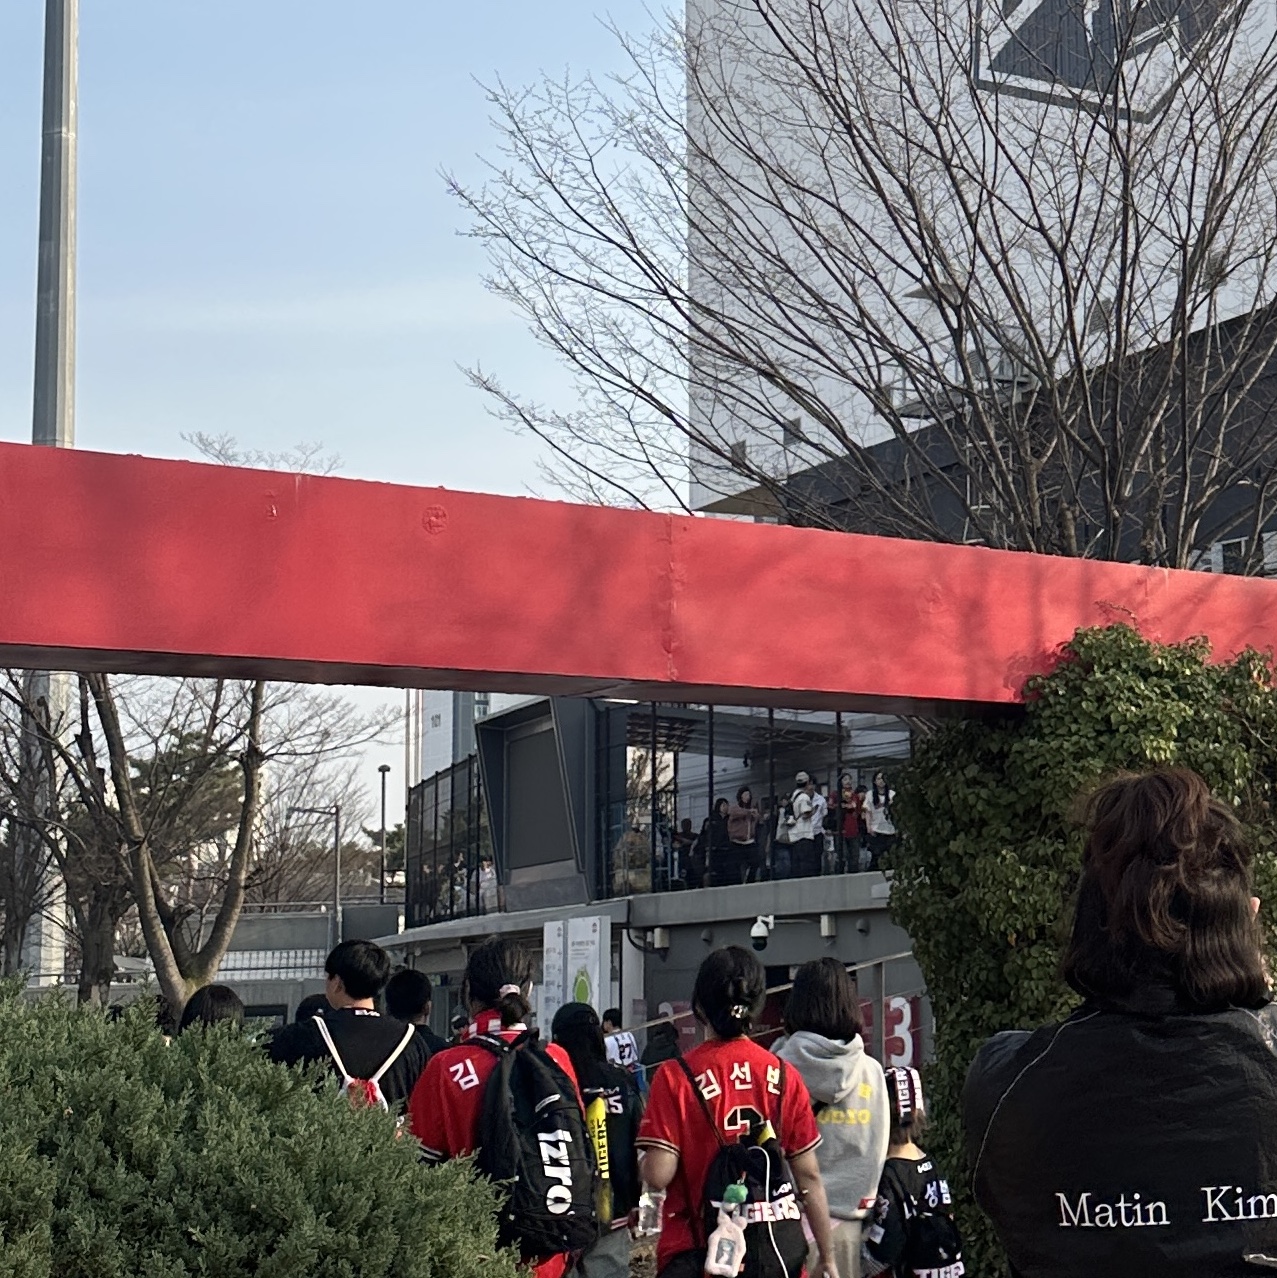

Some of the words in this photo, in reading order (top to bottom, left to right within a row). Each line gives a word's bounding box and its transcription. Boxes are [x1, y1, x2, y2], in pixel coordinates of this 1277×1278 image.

[889, 996, 914, 1067] 3
[449, 1057, 480, 1092] 김
[1055, 1191, 1171, 1228] Matin
